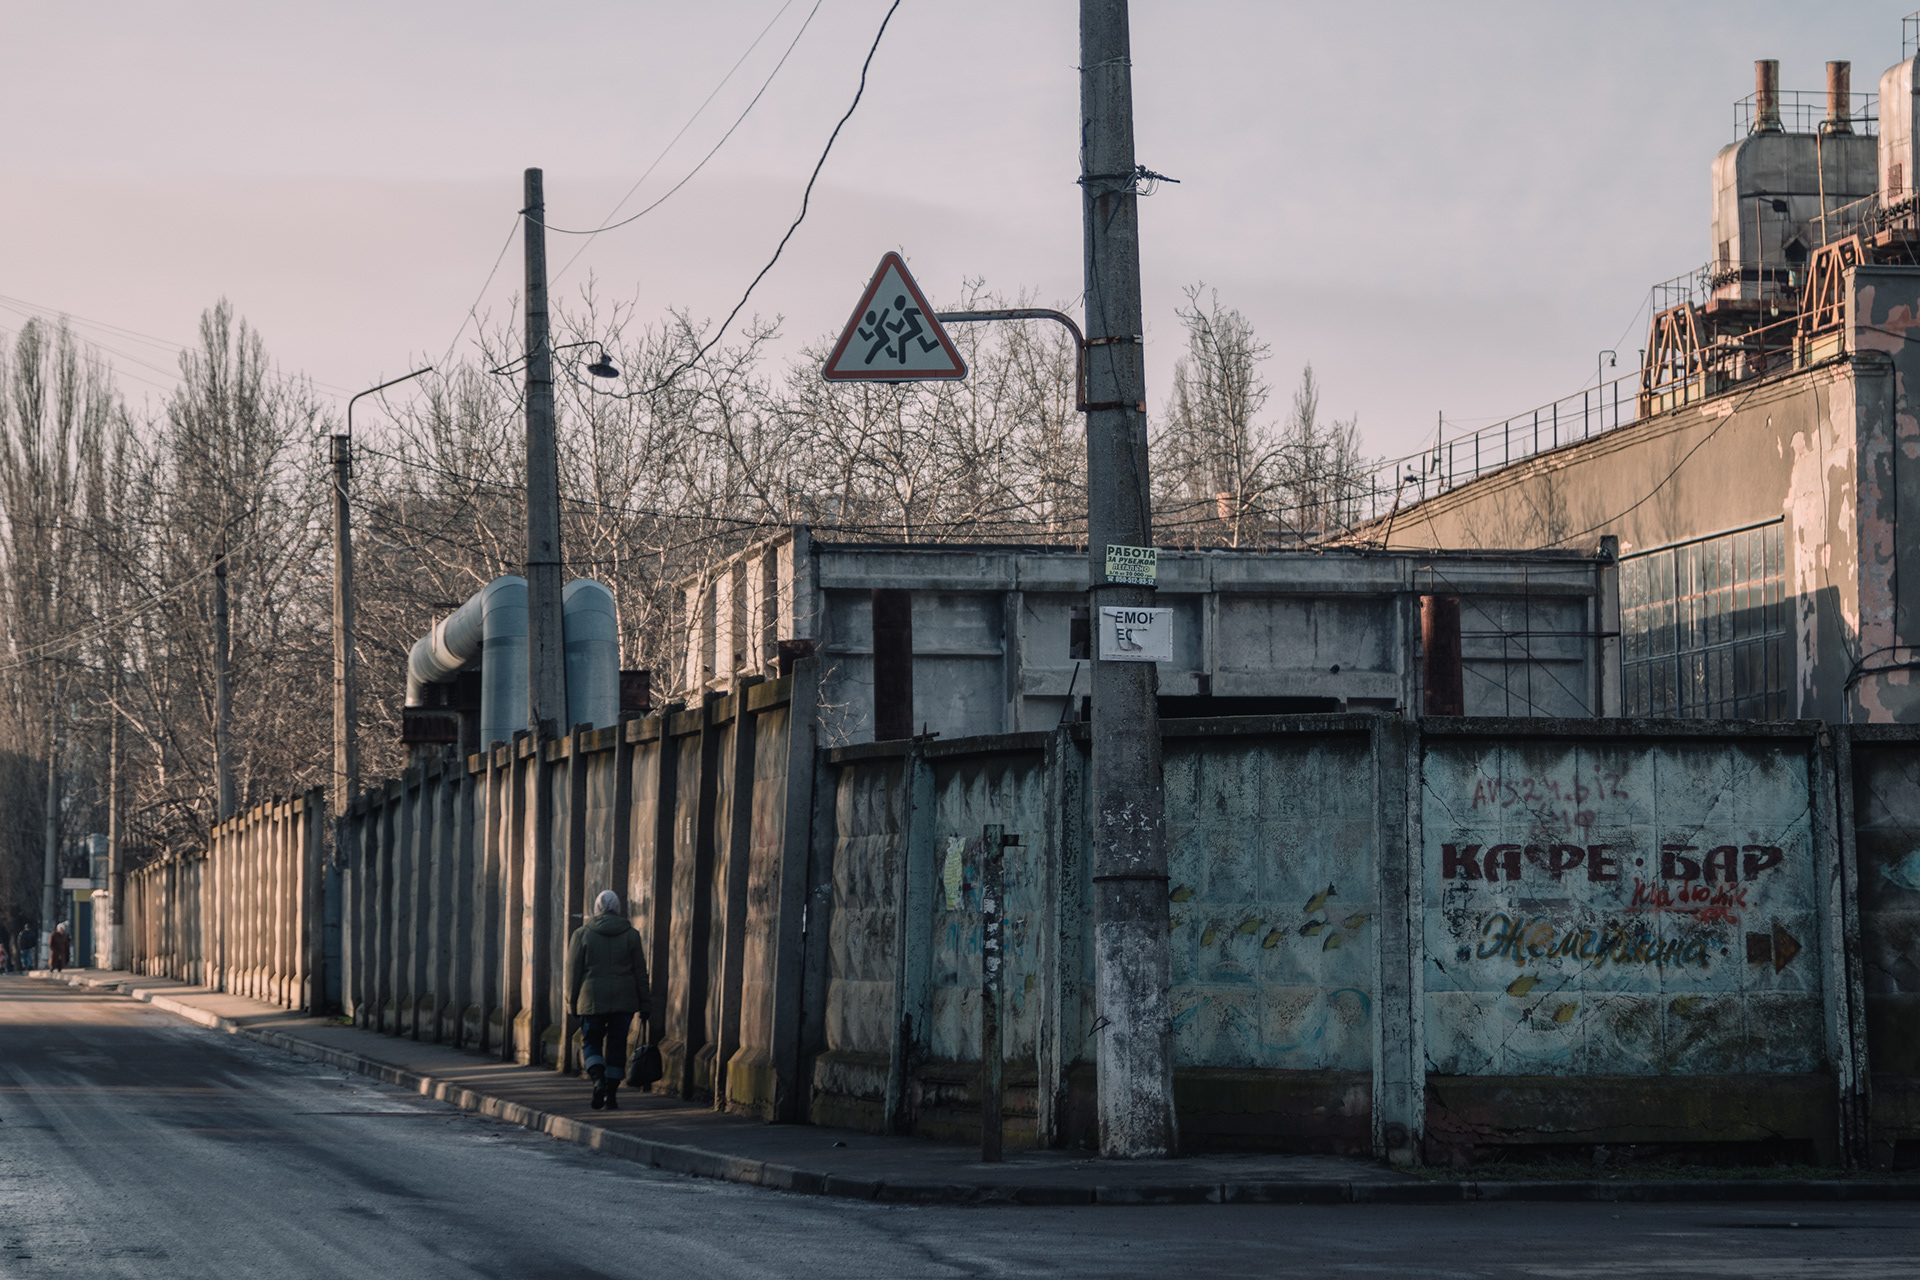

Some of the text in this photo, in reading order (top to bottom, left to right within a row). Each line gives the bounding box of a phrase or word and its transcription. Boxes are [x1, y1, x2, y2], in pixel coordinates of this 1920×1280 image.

[1107, 546, 1156, 559] РАБОТА
[1118, 557, 1156, 566] РУБЕЖОМ
[1661, 844, 1783, 883] БАР
